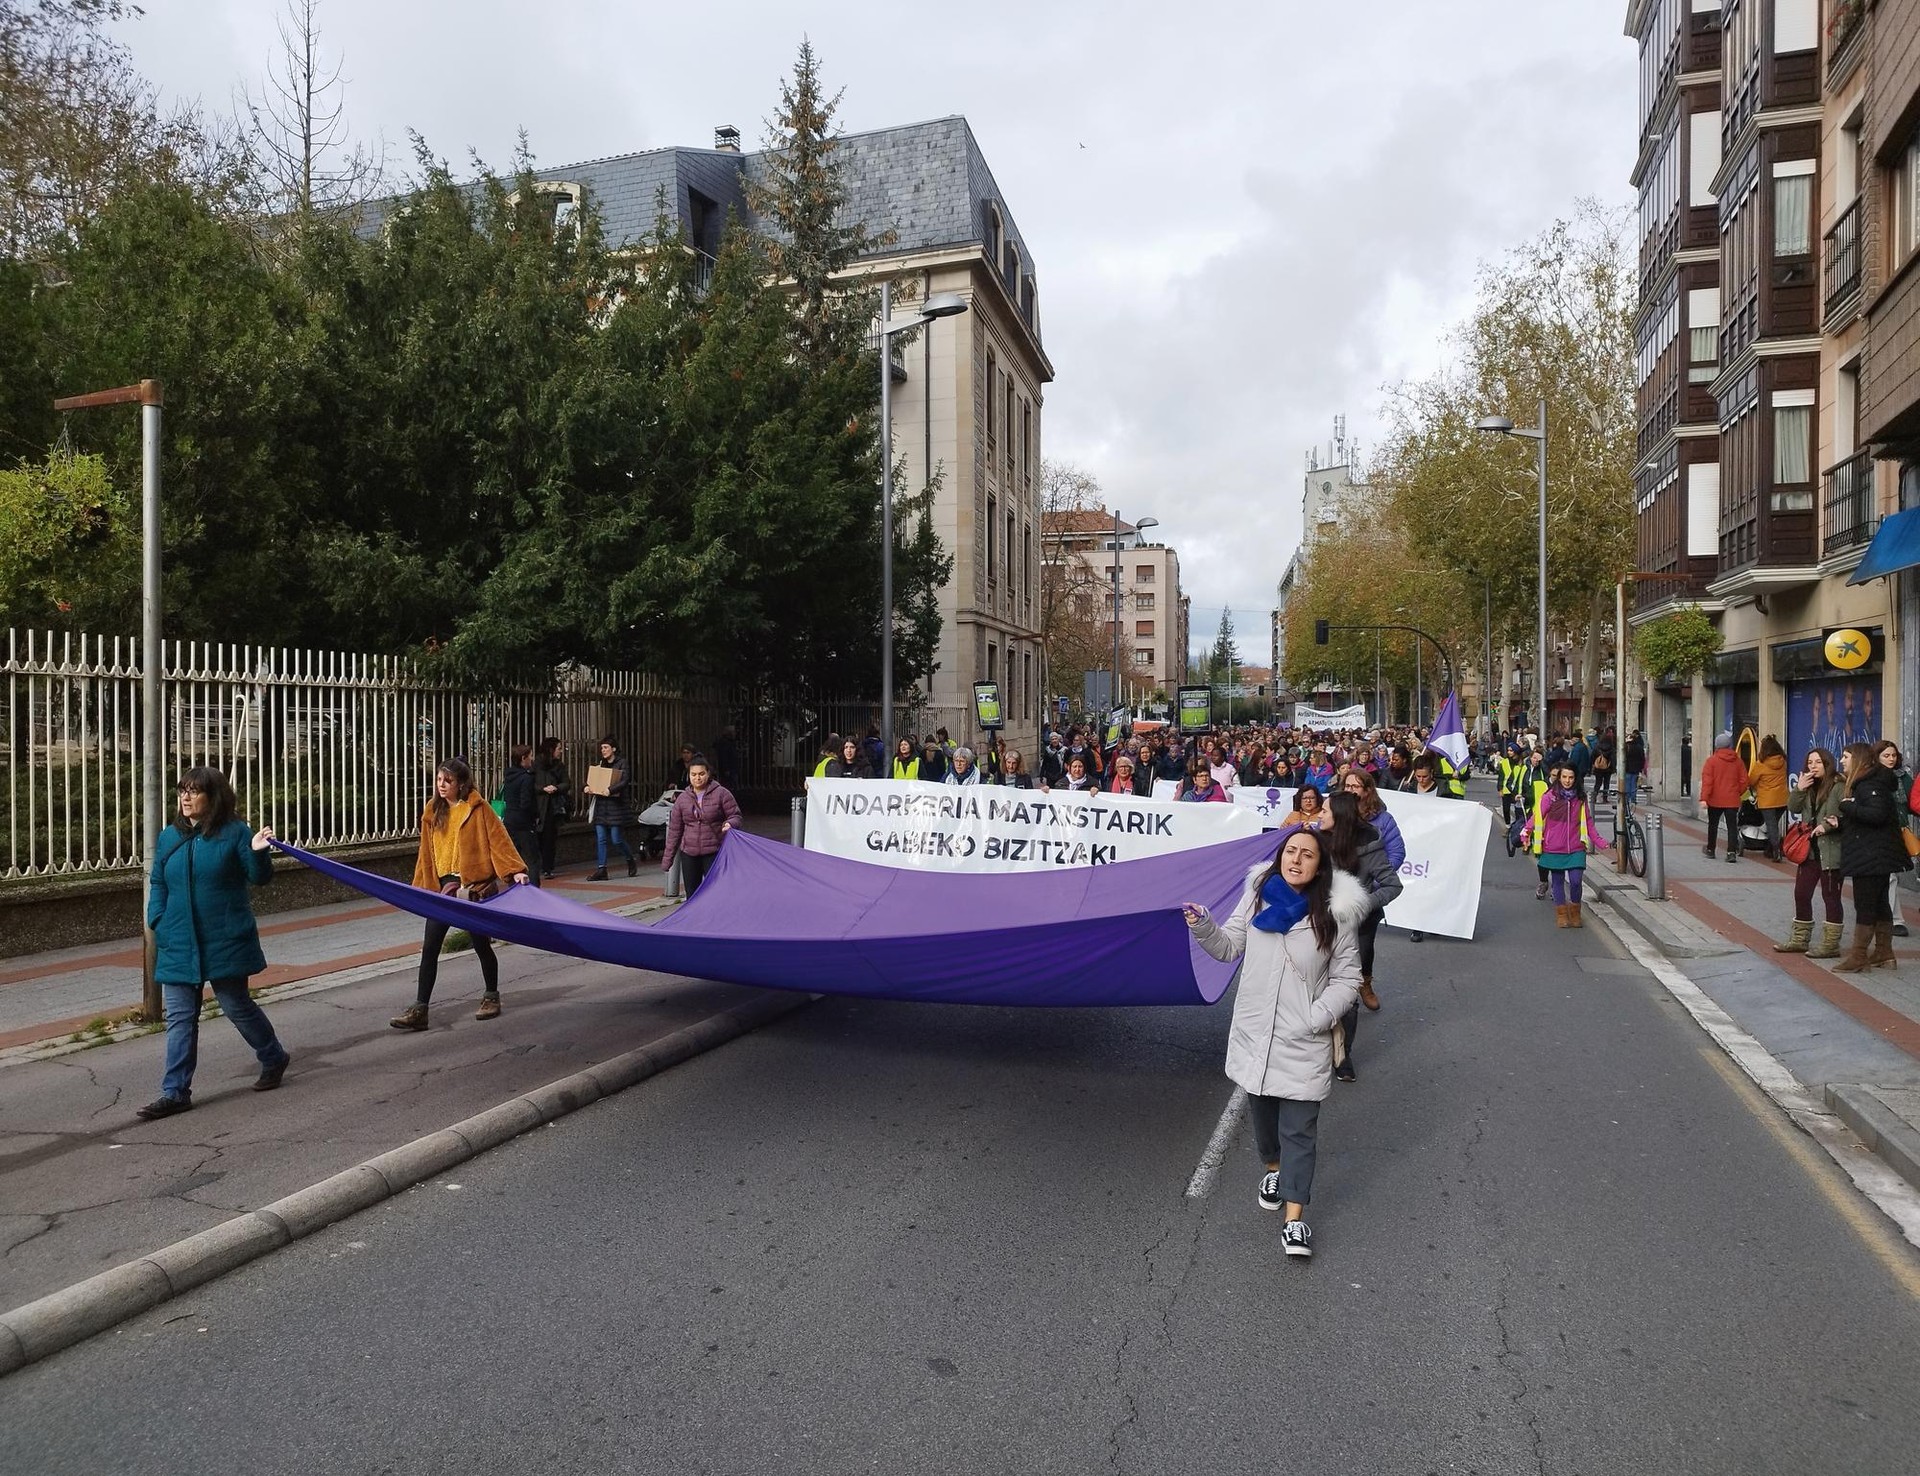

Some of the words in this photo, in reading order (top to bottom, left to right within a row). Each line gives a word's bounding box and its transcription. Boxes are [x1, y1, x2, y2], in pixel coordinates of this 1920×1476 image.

[825, 793, 981, 820] INDARKERIA
[988, 799, 1173, 836] MATXISTARIK
[866, 830, 976, 858] GABEKO
[983, 837, 1117, 866] BIZITZAK!
[1400, 860, 1430, 878] as!
